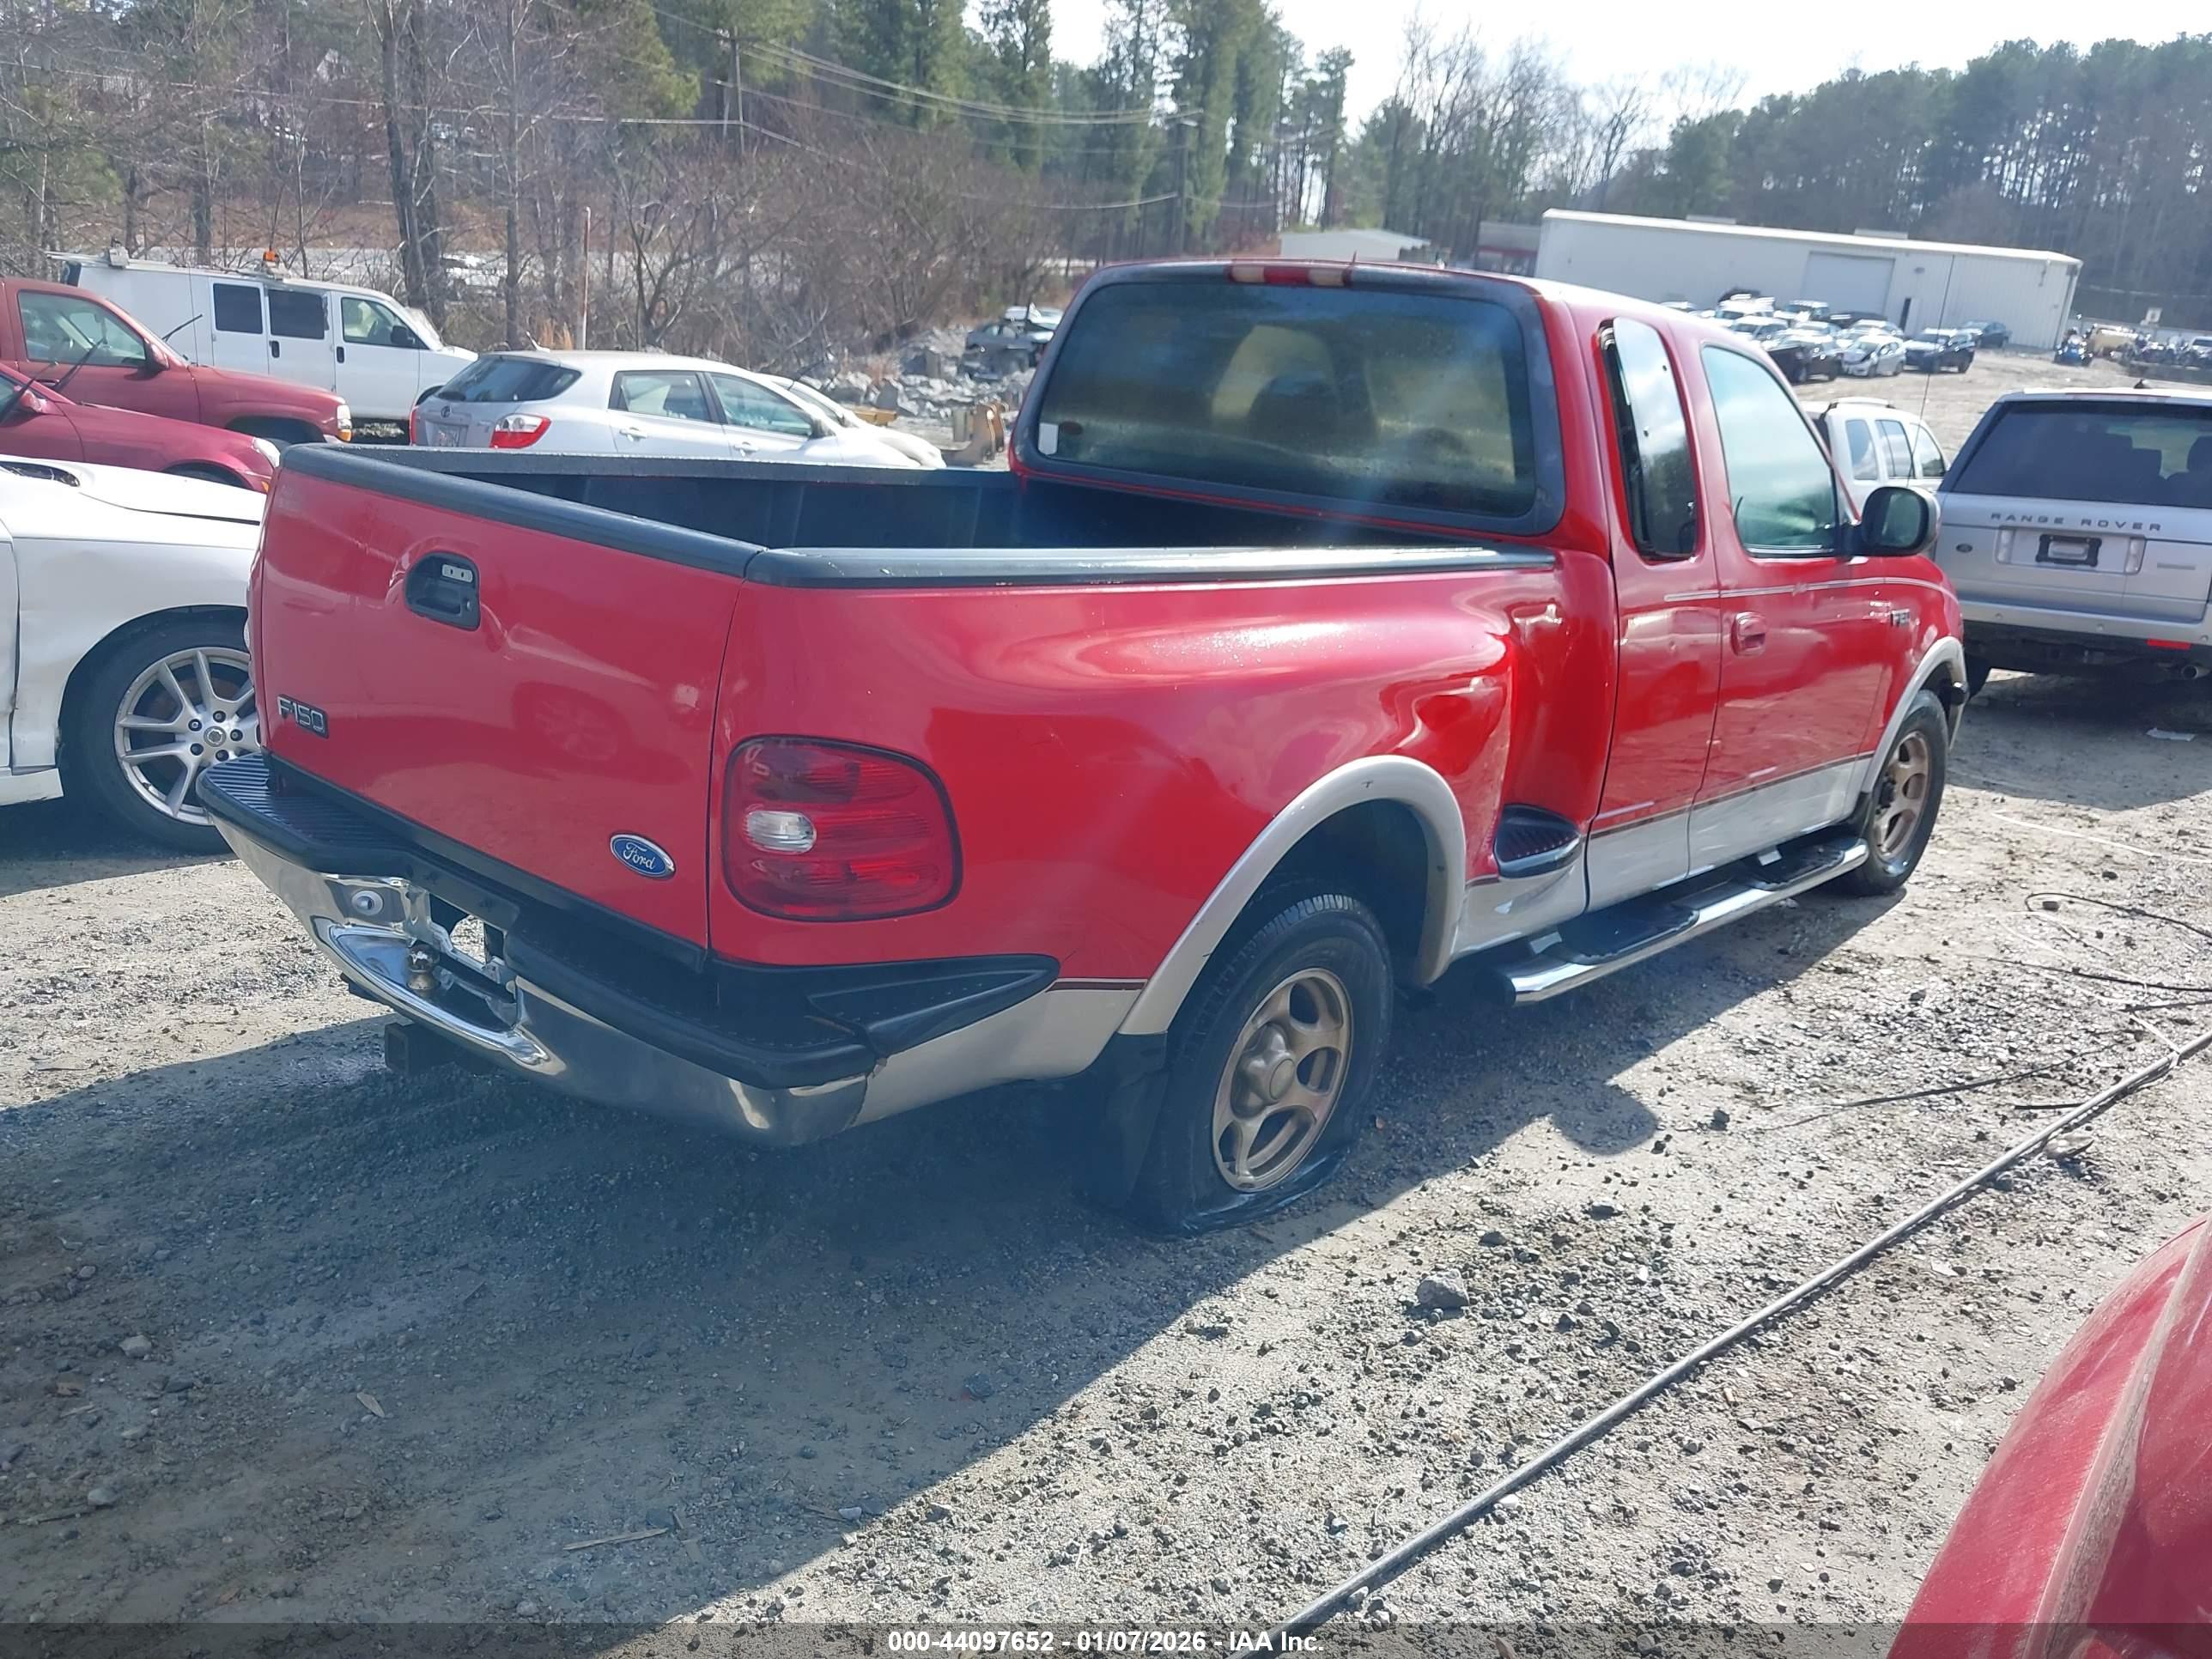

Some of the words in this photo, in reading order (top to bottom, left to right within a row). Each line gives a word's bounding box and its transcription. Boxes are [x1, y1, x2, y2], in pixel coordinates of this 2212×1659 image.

[1990, 513, 2064, 525] RANGE
[2081, 518, 2161, 532] ROVER
[623, 842, 656, 870] Ford
